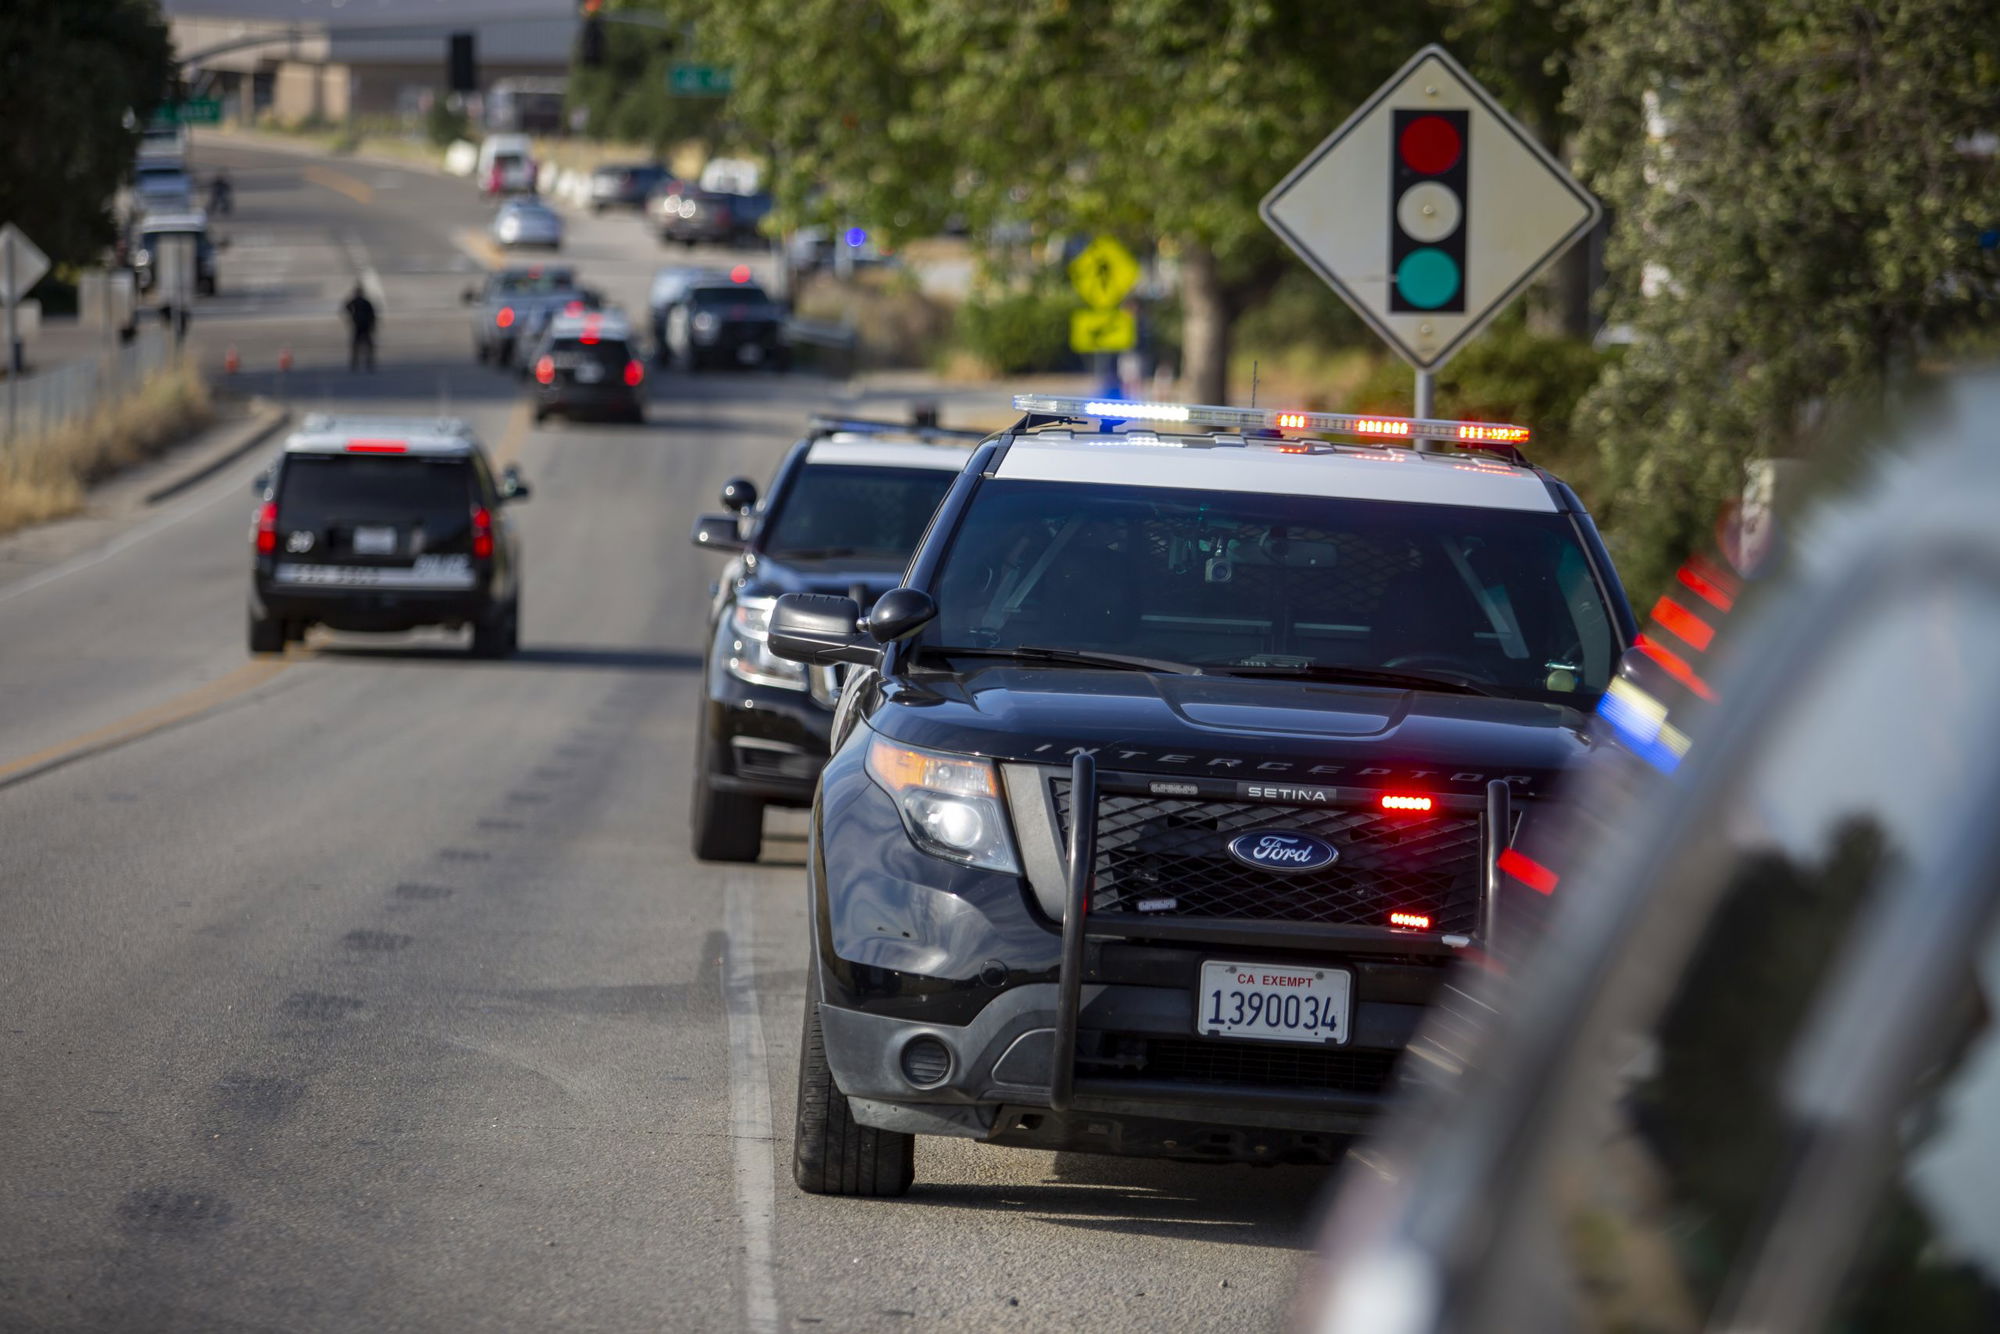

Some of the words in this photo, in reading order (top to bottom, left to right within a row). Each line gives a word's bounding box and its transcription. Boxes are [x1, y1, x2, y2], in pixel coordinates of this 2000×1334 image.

[1033, 743, 1532, 785] INTERCEPTOR
[1247, 786, 1327, 802] SETINA
[1253, 835, 1313, 862] Ford
[1237, 973, 1256, 985] CA
[1262, 974, 1314, 988] EXEMPT
[1207, 989, 1337, 1032] 1390034
